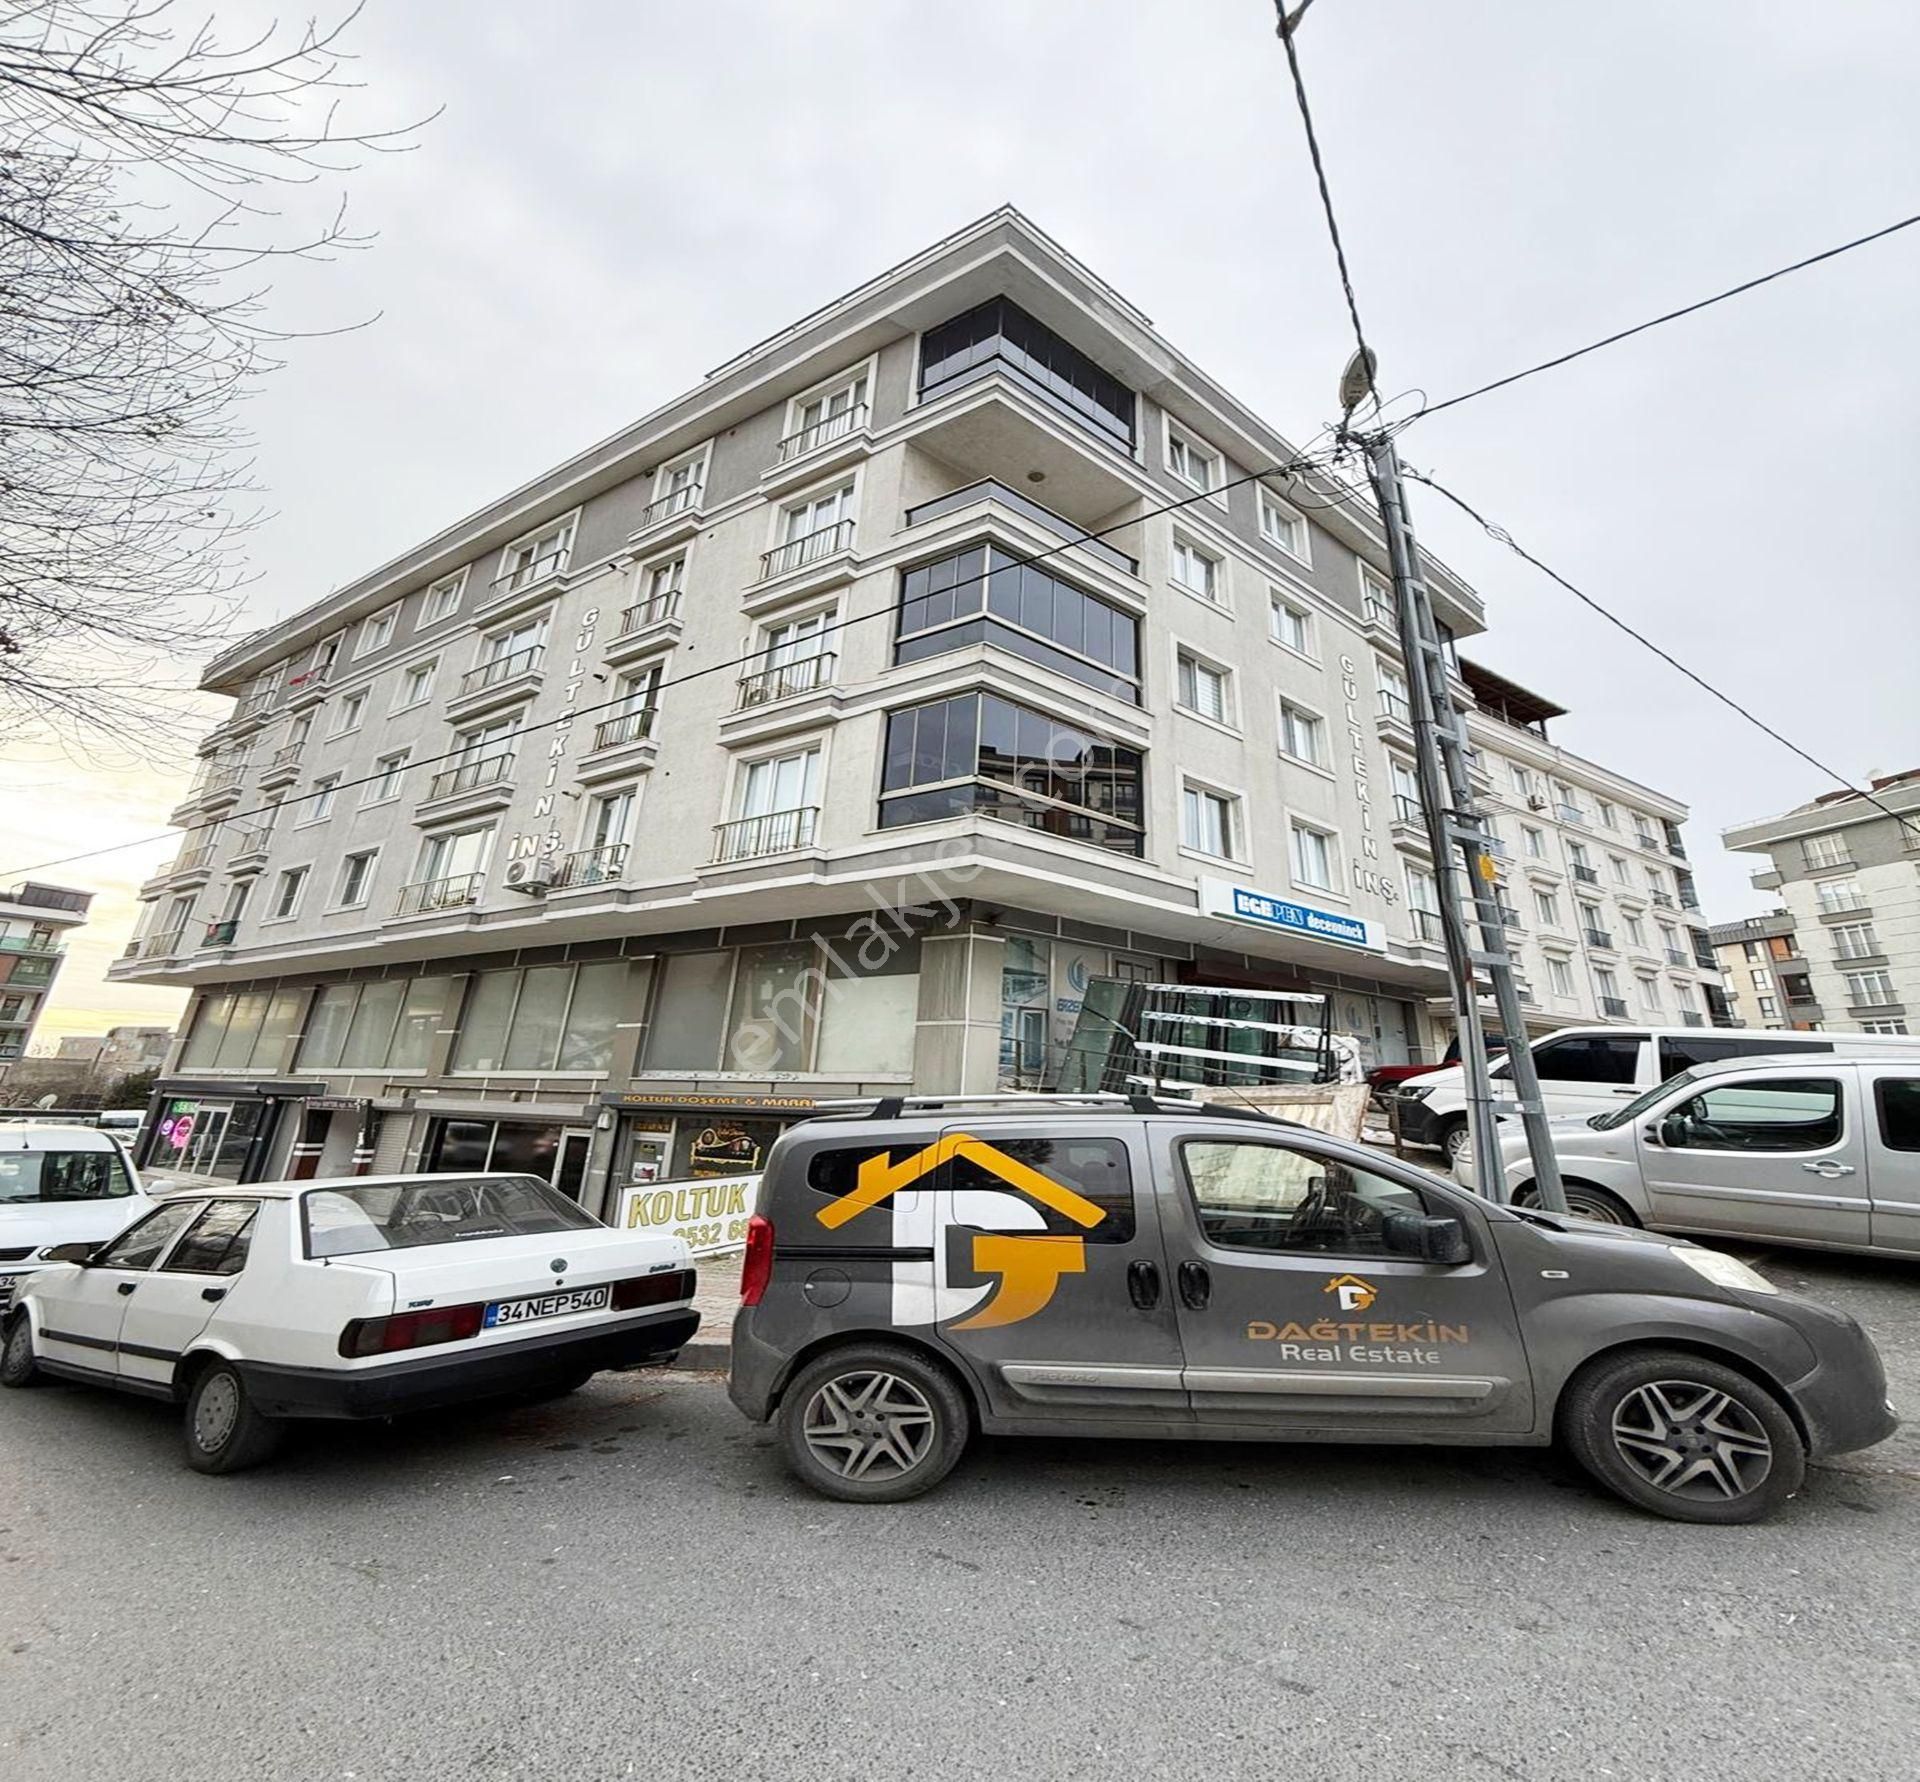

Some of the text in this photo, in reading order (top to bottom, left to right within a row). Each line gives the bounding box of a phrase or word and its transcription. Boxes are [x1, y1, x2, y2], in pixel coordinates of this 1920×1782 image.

[533, 607, 599, 819] GÜLTEKİN
[1339, 654, 1378, 861] GÜLTEKİN
[1237, 894, 1364, 940] EGEPEN deceuninck
[623, 1095, 673, 1104] KOLTUK
[745, 1096, 756, 1106] &
[762, 1097, 816, 1108] MARA
[627, 1183, 749, 1229] KOLTUK
[498, 1289, 605, 1322] 34 NEP 540
[1248, 1318, 1469, 1343] DAĞTEKİN
[1280, 1343, 1441, 1364] Real Estate
